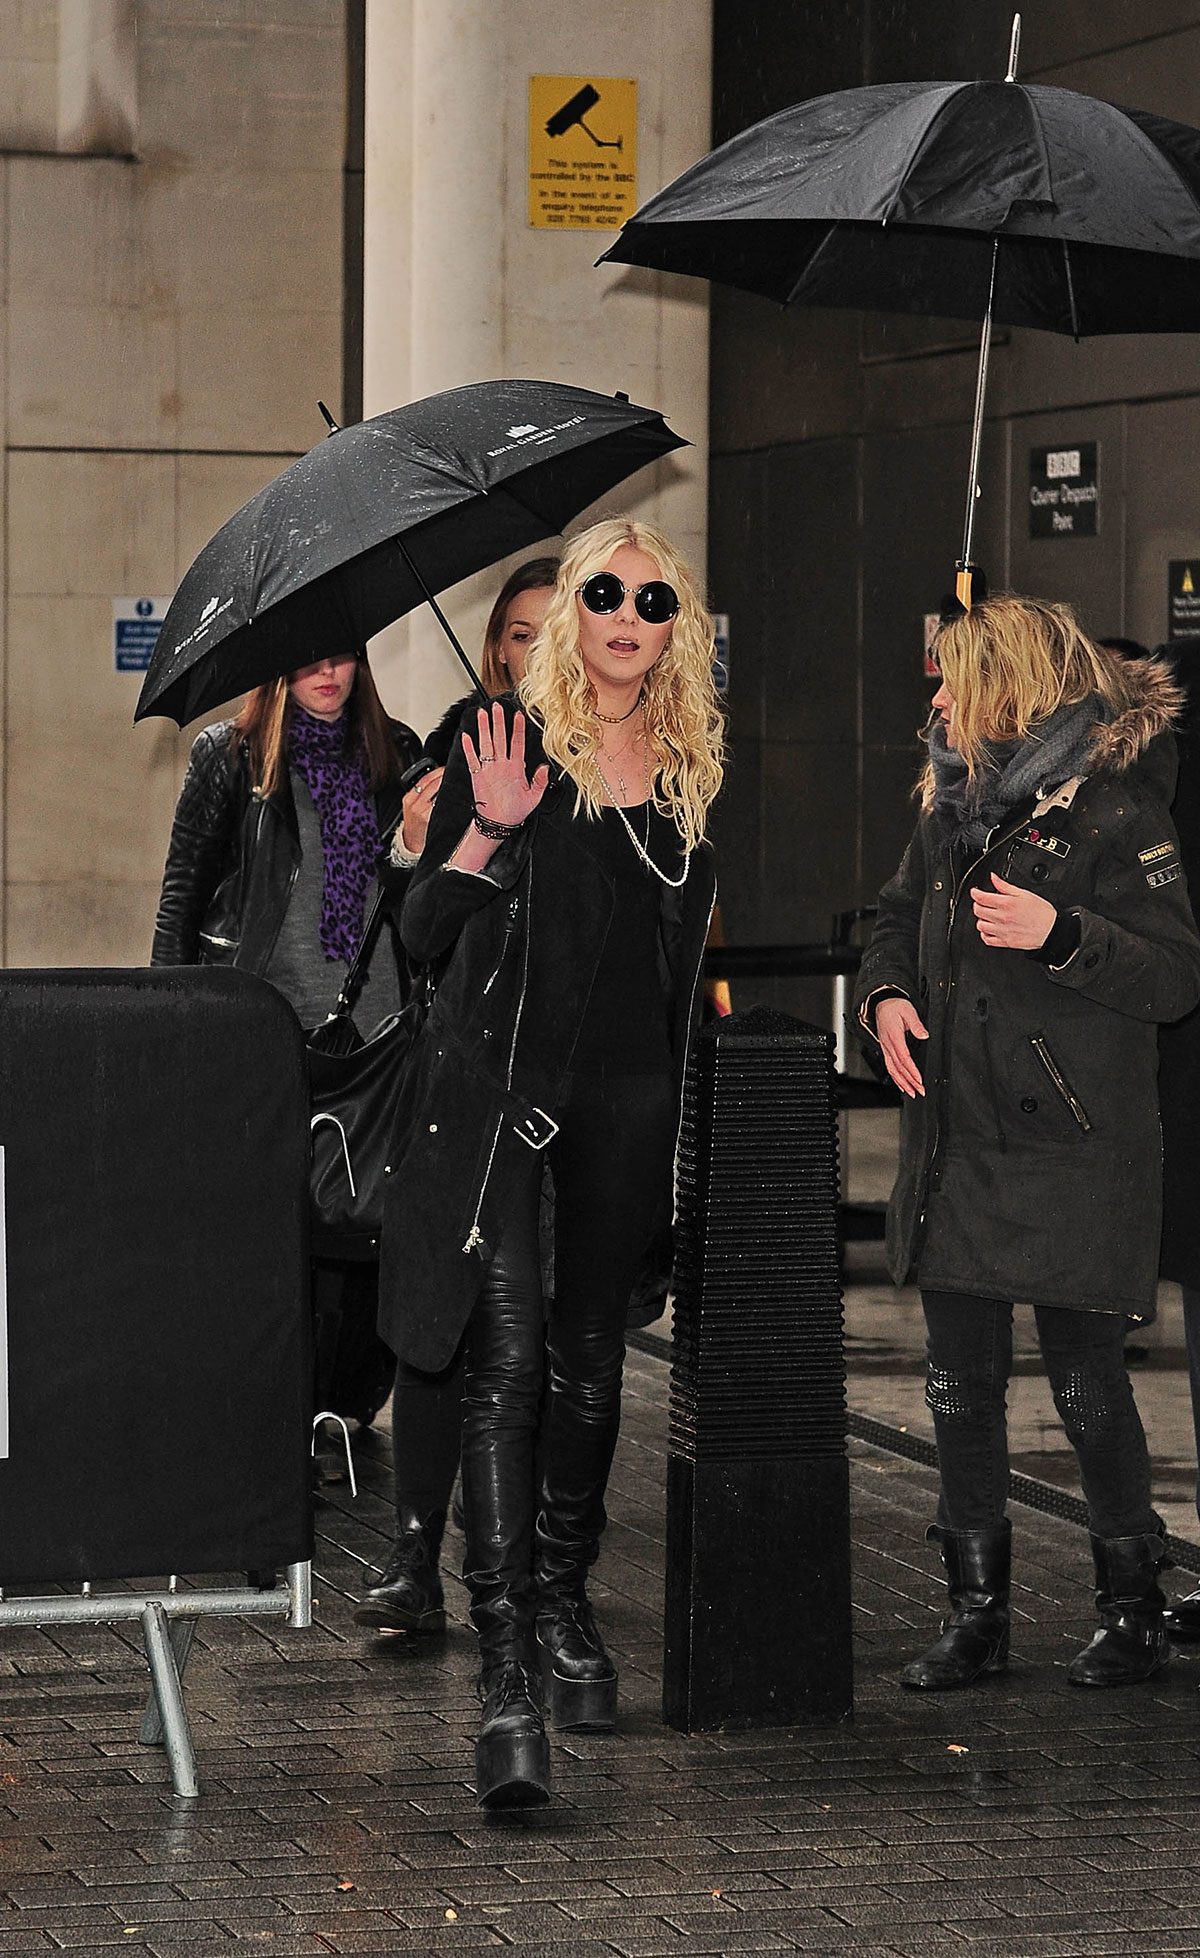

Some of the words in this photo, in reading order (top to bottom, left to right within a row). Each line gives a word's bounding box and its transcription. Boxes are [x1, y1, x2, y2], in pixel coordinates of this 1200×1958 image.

[548, 159, 567, 168] This
[572, 162, 605, 170] system
[530, 172, 576, 181] controlled
[580, 173, 591, 182] by
[595, 173, 610, 181] the
[614, 173, 635, 182] BBC
[552, 190, 567, 198] the
[579, 204, 623, 213] telephone
[1046, 450, 1081, 478] BBC
